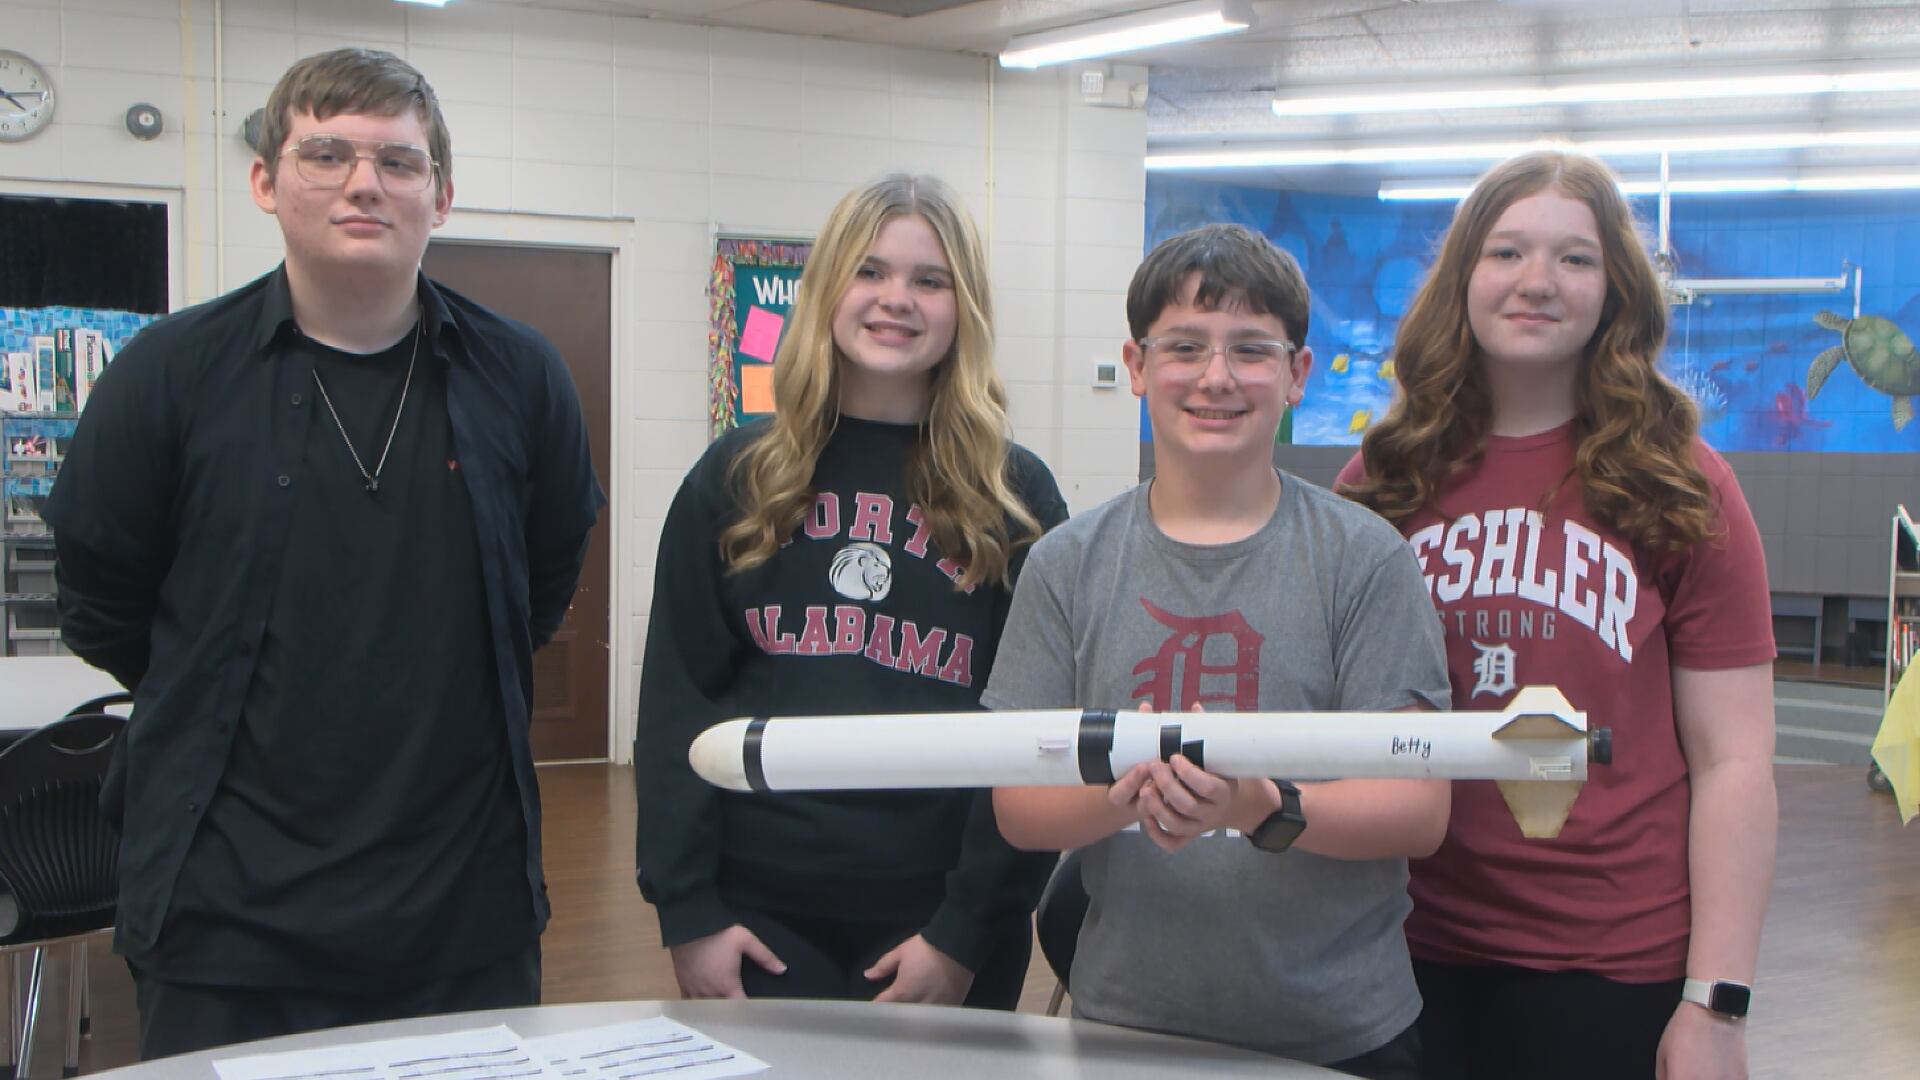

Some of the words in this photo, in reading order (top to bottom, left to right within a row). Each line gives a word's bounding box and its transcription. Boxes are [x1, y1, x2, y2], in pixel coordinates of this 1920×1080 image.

[780, 491, 975, 595] ORT
[1409, 508, 1638, 664] ESHLER
[1392, 736, 1432, 760] Betty
